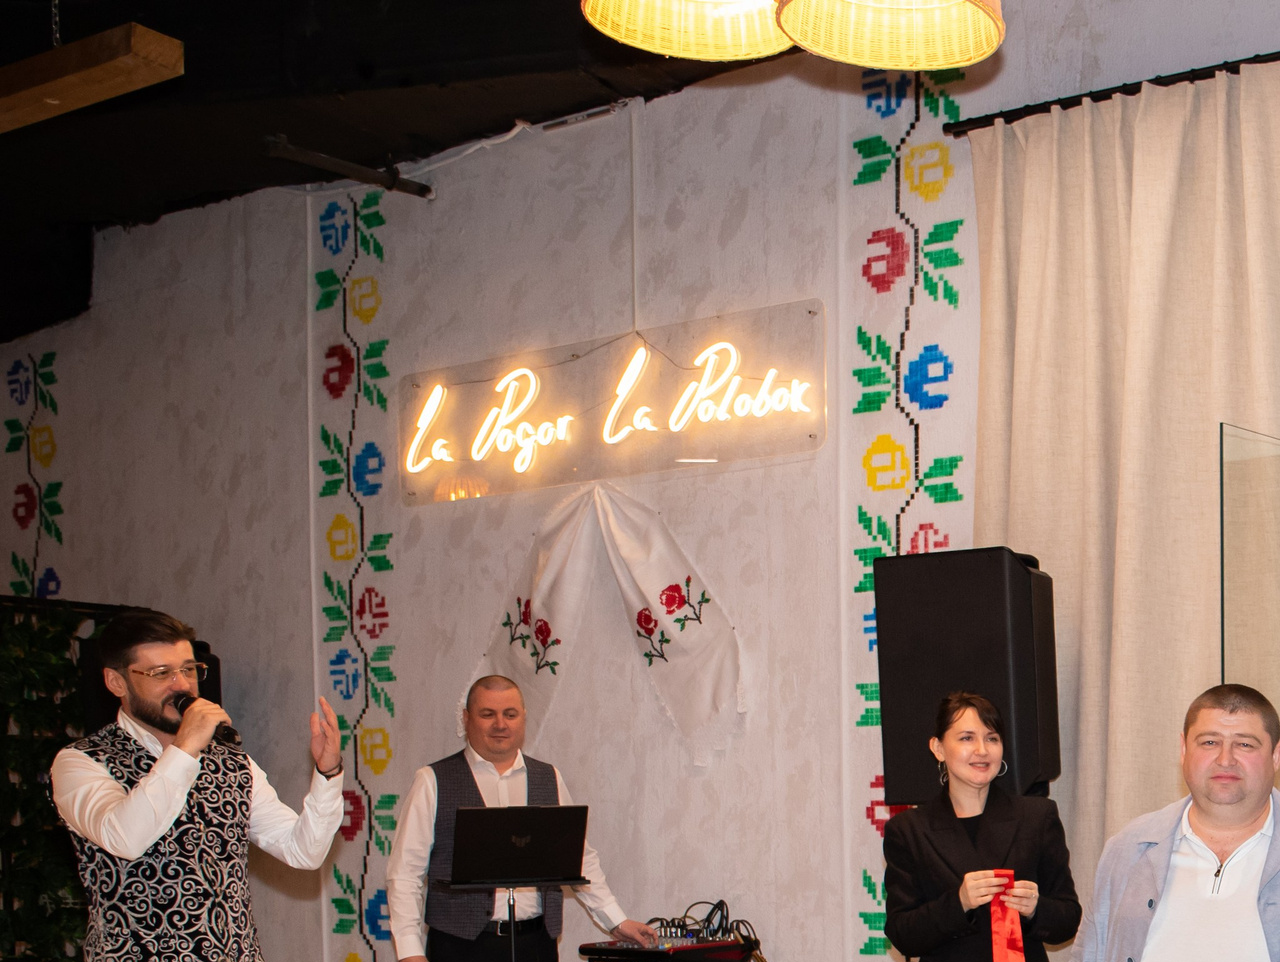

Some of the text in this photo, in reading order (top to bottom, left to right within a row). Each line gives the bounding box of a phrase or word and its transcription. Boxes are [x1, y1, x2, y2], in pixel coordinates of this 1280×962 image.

[406, 383, 454, 474] La
[470, 367, 575, 474] Pogor
[602, 346, 658, 445] La
